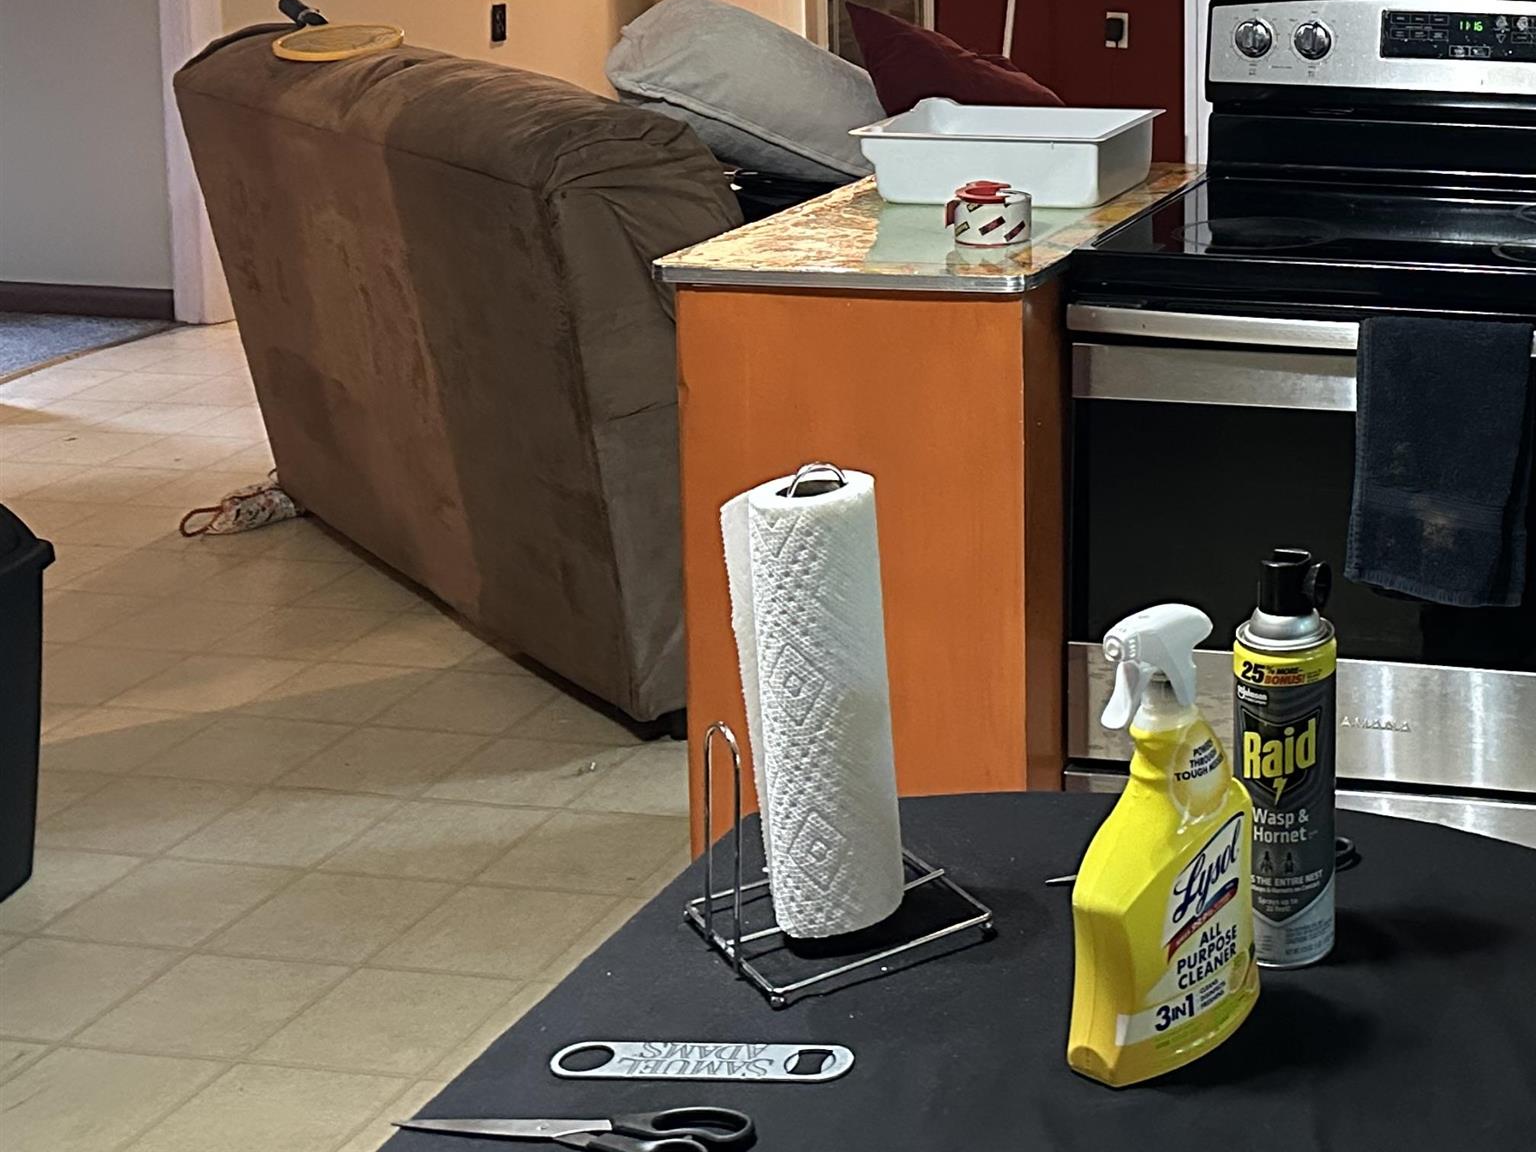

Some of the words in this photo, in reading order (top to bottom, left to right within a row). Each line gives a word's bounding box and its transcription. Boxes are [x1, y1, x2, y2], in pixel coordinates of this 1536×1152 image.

[1264, 674, 1305, 685] BONUS!
[1243, 718, 1317, 779] Raid
[1174, 766, 1209, 781] TOUGH
[1252, 807, 1295, 828] Wasp
[1298, 808, 1310, 823] &
[1253, 826, 1308, 843] Hornet
[1172, 819, 1241, 923] Lysol
[1256, 876, 1272, 886] THE
[1274, 876, 1304, 887] ENTIRE
[1199, 922, 1222, 947] ALL
[1176, 924, 1238, 974] PURPOSE
[1178, 942, 1237, 990] CLEANER
[641, 1042, 768, 1059] ADAMS
[617, 1056, 775, 1076] SAMUEL
